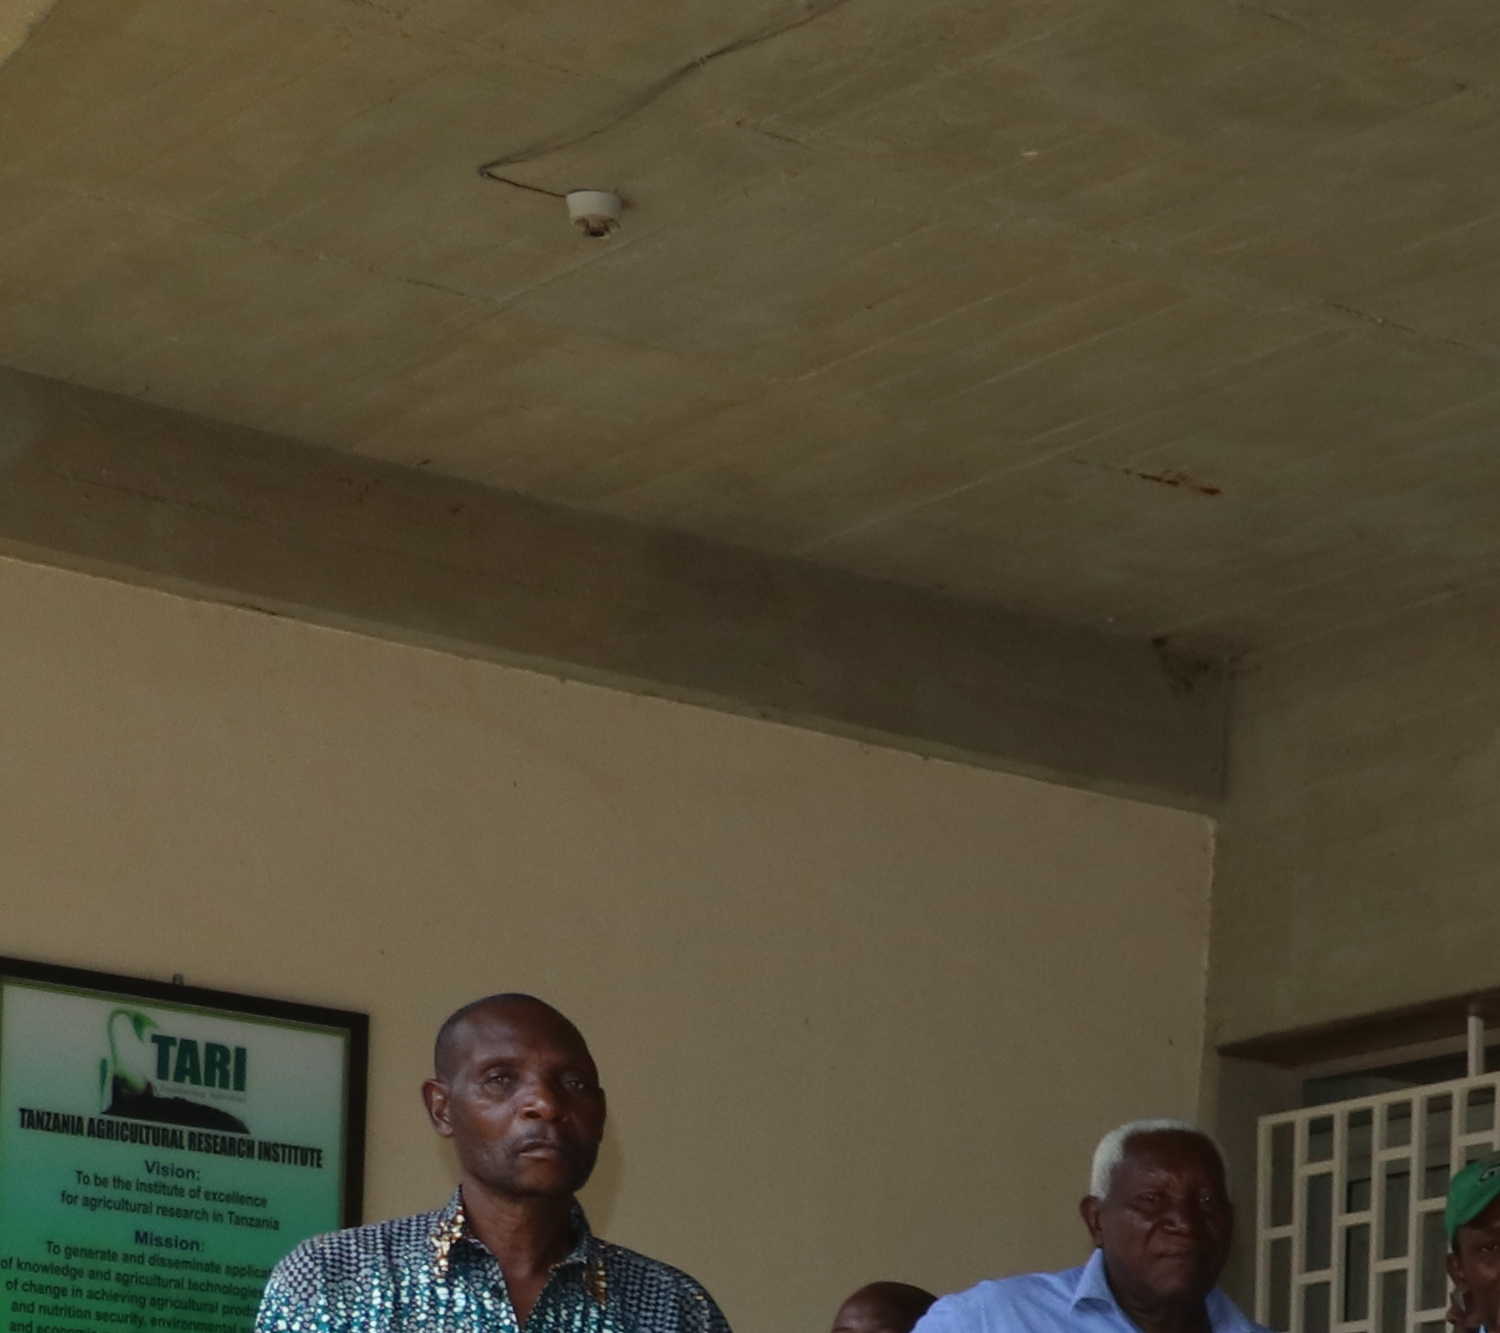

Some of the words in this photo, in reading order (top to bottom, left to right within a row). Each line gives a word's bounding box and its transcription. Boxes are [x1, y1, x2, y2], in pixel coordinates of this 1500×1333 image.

[150, 1033, 247, 1092] TARI
[19, 1108, 84, 1136] TANZANIA
[87, 1117, 186, 1151] AGRICULTURAL
[189, 1134, 255, 1159] RESEARCH
[258, 1140, 323, 1169] INSTITUTE
[144, 1159, 201, 1181] Vision:
[75, 1170, 91, 1186] To
[94, 1173, 110, 1188] be
[113, 1174, 132, 1191] the
[136, 1179, 184, 1198] institute
[188, 1184, 202, 1200] of
[204, 1190, 268, 1208] excellence
[60, 1189, 80, 1206] for
[82, 1195, 153, 1214] agricultural
[156, 1205, 209, 1222] research
[213, 1209, 223, 1223] in
[227, 1211, 280, 1231] Tanzania
[46, 1240, 61, 1255] To
[64, 1245, 119, 1262] generate
[122, 1252, 145, 1265] and
[148, 1253, 222, 1273] disseminate
[134, 1229, 205, 1252] Mission:
[1, 1257, 13, 1269] of
[16, 1258, 84, 1280] knowledge
[88, 1268, 111, 1281] and
[115, 1271, 184, 1289] agricultural
[5, 1278, 18, 1291] of
[21, 1280, 68, 1299] change
[71, 1285, 83, 1298] in
[86, 1287, 147, 1309] achieving
[149, 1295, 218, 1313] agricultural
[11, 1301, 35, 1314] and
[38, 1304, 91, 1320] nutrition
[9, 1321, 33, 1333] and
